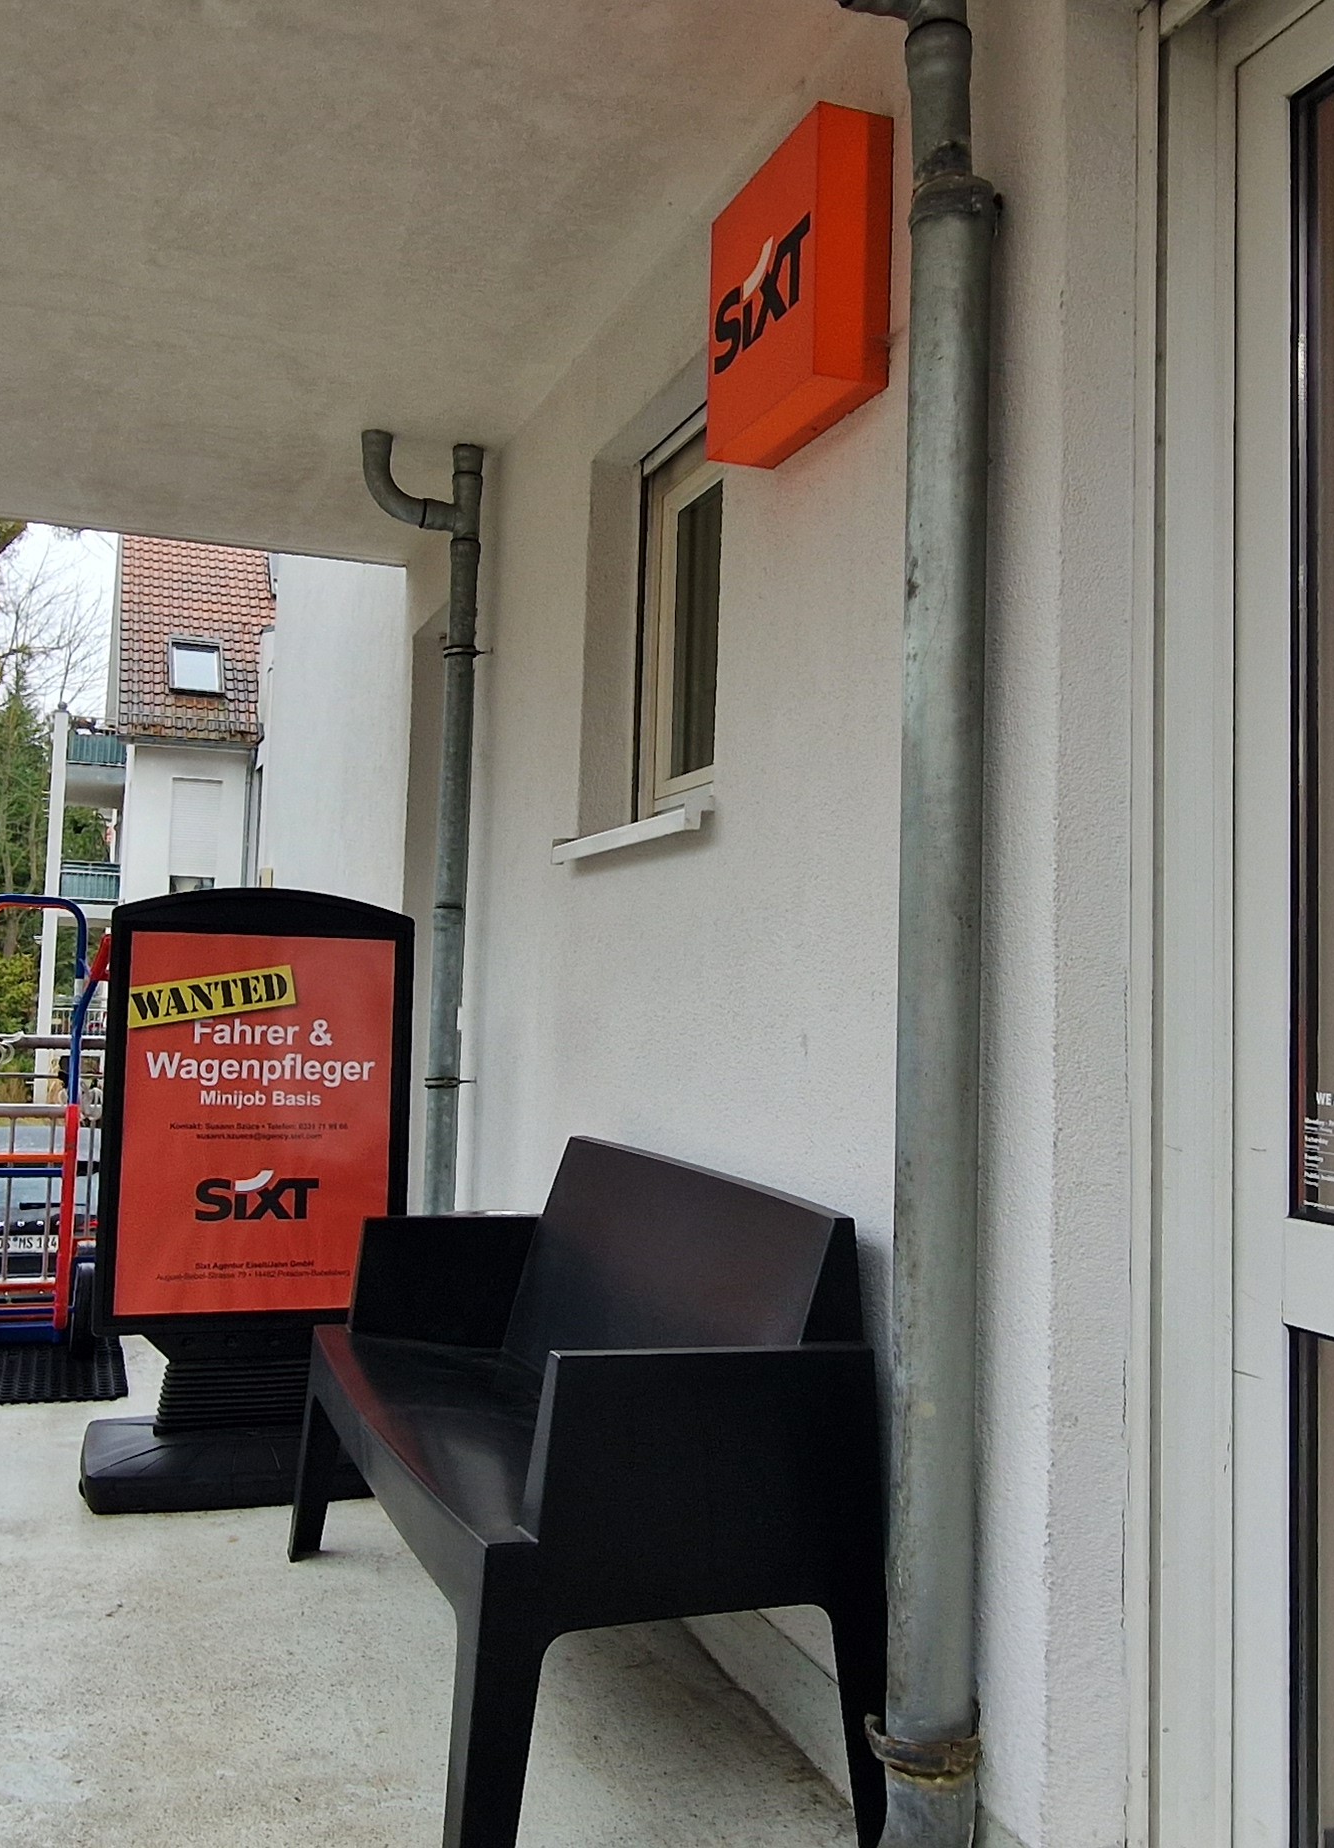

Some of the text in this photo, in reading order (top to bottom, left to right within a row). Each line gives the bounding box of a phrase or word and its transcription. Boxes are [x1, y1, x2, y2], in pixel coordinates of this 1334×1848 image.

[130, 973, 287, 1020] WANTED
[193, 1018, 333, 1046] Fahrer &
[146, 1051, 375, 1087] Wagenpfleger
[200, 1090, 321, 1109] Minijob Basis
[1315, 1092, 1332, 1106] WE
[212, 1261, 244, 1271] Agentur
[290, 1259, 315, 1268] GmbH
